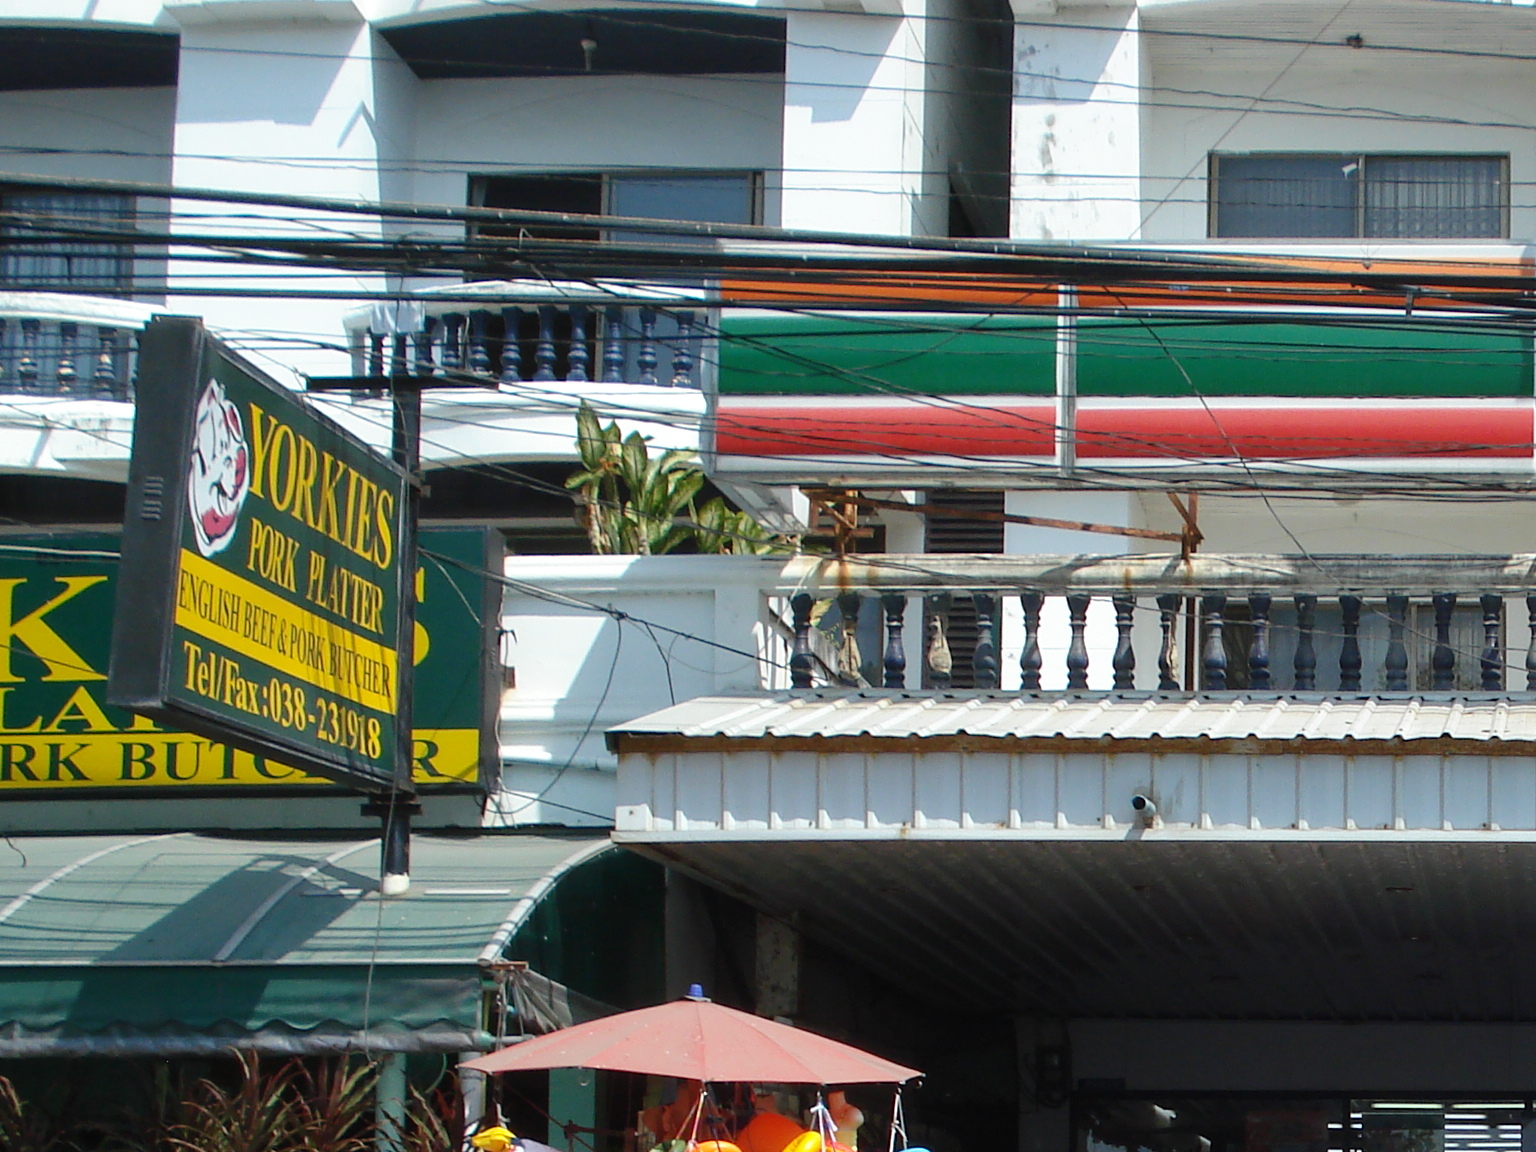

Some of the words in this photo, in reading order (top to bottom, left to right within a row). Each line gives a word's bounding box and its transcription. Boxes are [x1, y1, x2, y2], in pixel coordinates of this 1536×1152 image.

[247, 402, 395, 571] YORKIES
[178, 568, 241, 632] ENGLISH
[243, 603, 276, 646] BEEF
[276, 621, 288, 655] &
[289, 626, 327, 674] PORK
[328, 643, 391, 699] BUTCHER
[247, 516, 300, 594] PORK
[307, 550, 384, 635] PLATTER
